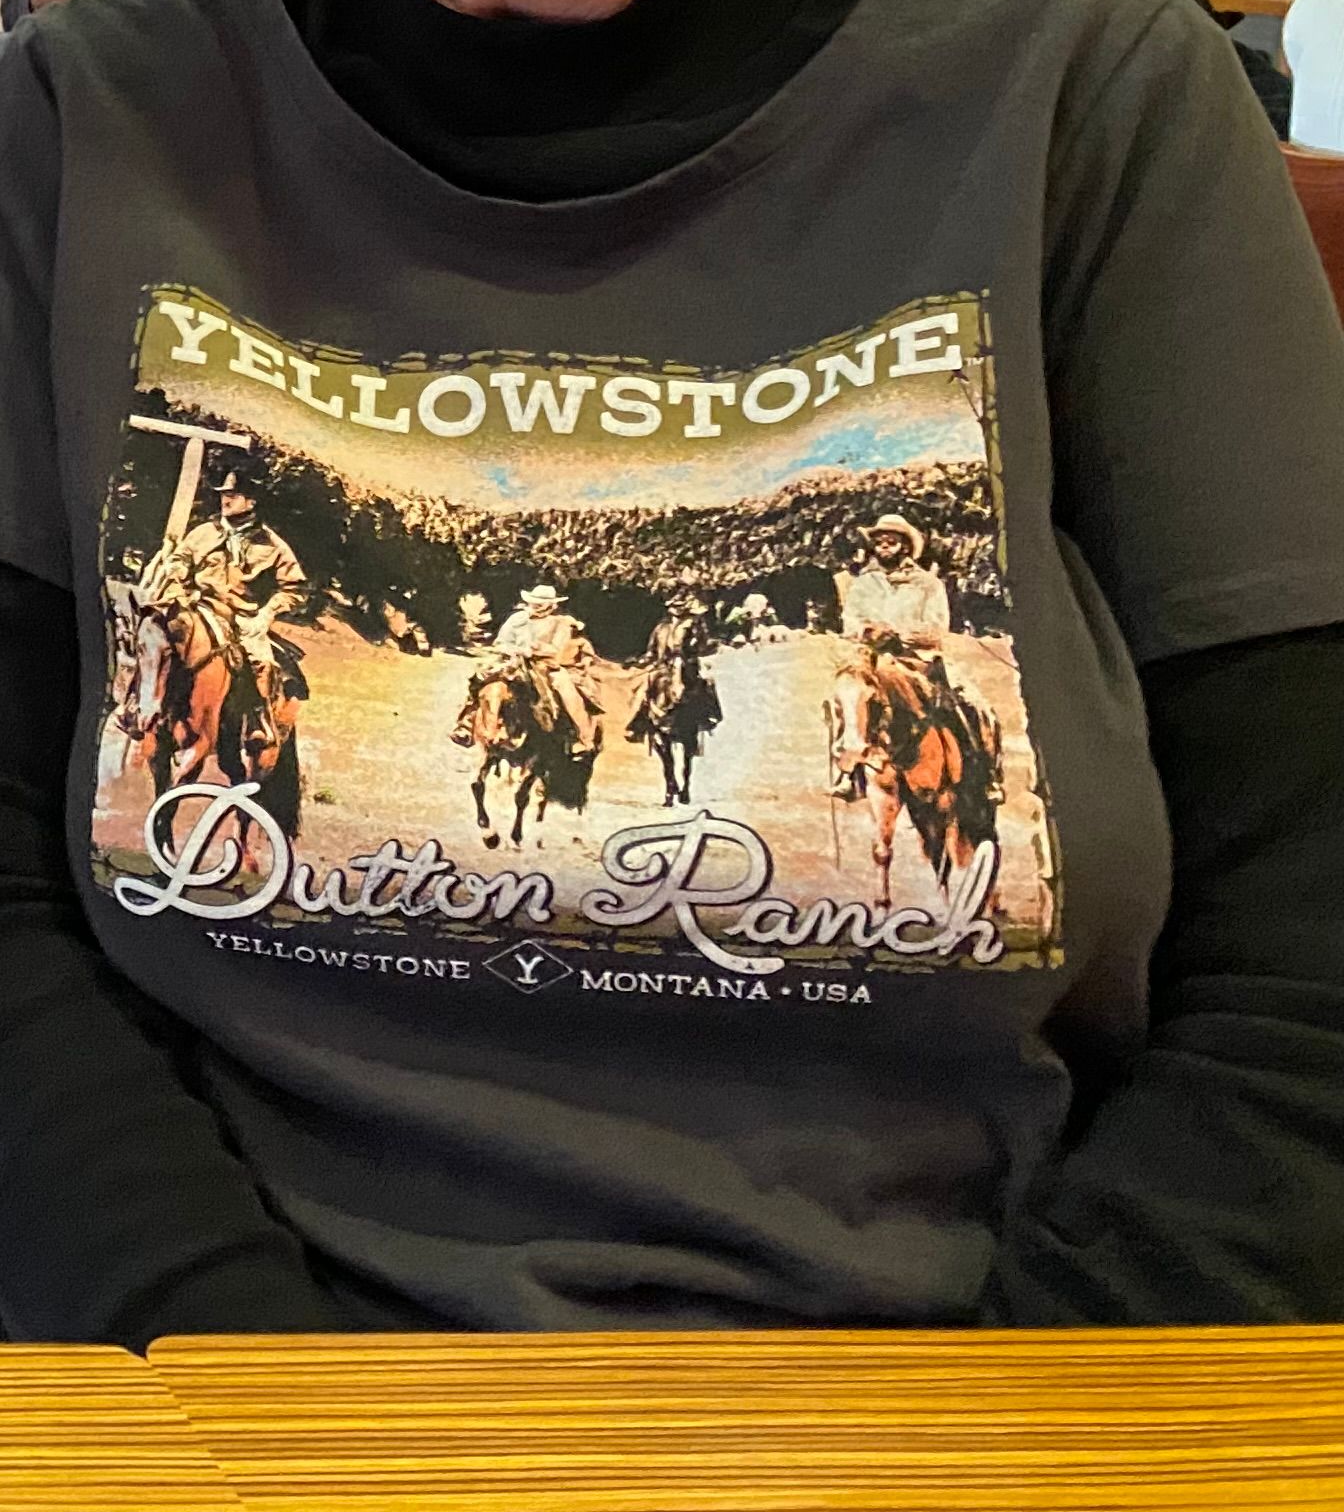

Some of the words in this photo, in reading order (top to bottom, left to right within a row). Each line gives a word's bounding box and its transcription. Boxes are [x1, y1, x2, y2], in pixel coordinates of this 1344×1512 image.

[157, 301, 963, 438] YELLOWSTONE
[113, 780, 554, 922] Dutton
[580, 808, 1004, 974] Ranch
[206, 931, 471, 980] YELLOWSTONE
[580, 969, 771, 1001] MONTANA
[802, 982, 873, 1005] USA
